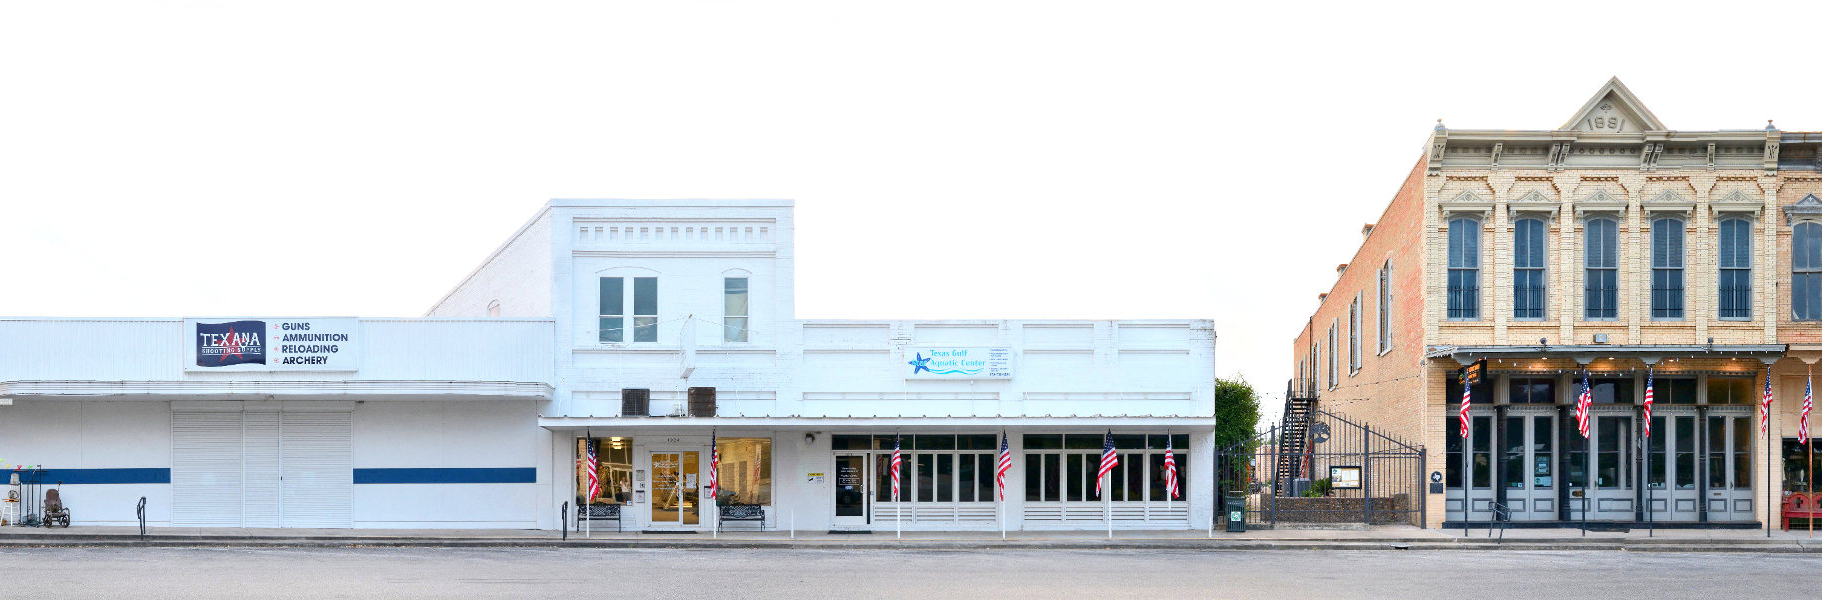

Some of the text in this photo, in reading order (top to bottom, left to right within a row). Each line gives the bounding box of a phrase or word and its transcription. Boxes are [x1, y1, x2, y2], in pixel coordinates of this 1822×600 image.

[282, 323, 311, 331] GUNS
[200, 332, 261, 347] TEXANA
[282, 334, 348, 342] AMMUNITION
[282, 345, 338, 353] RELOADING
[952, 349, 968, 357] Gulf
[282, 356, 328, 364] ARCHERY
